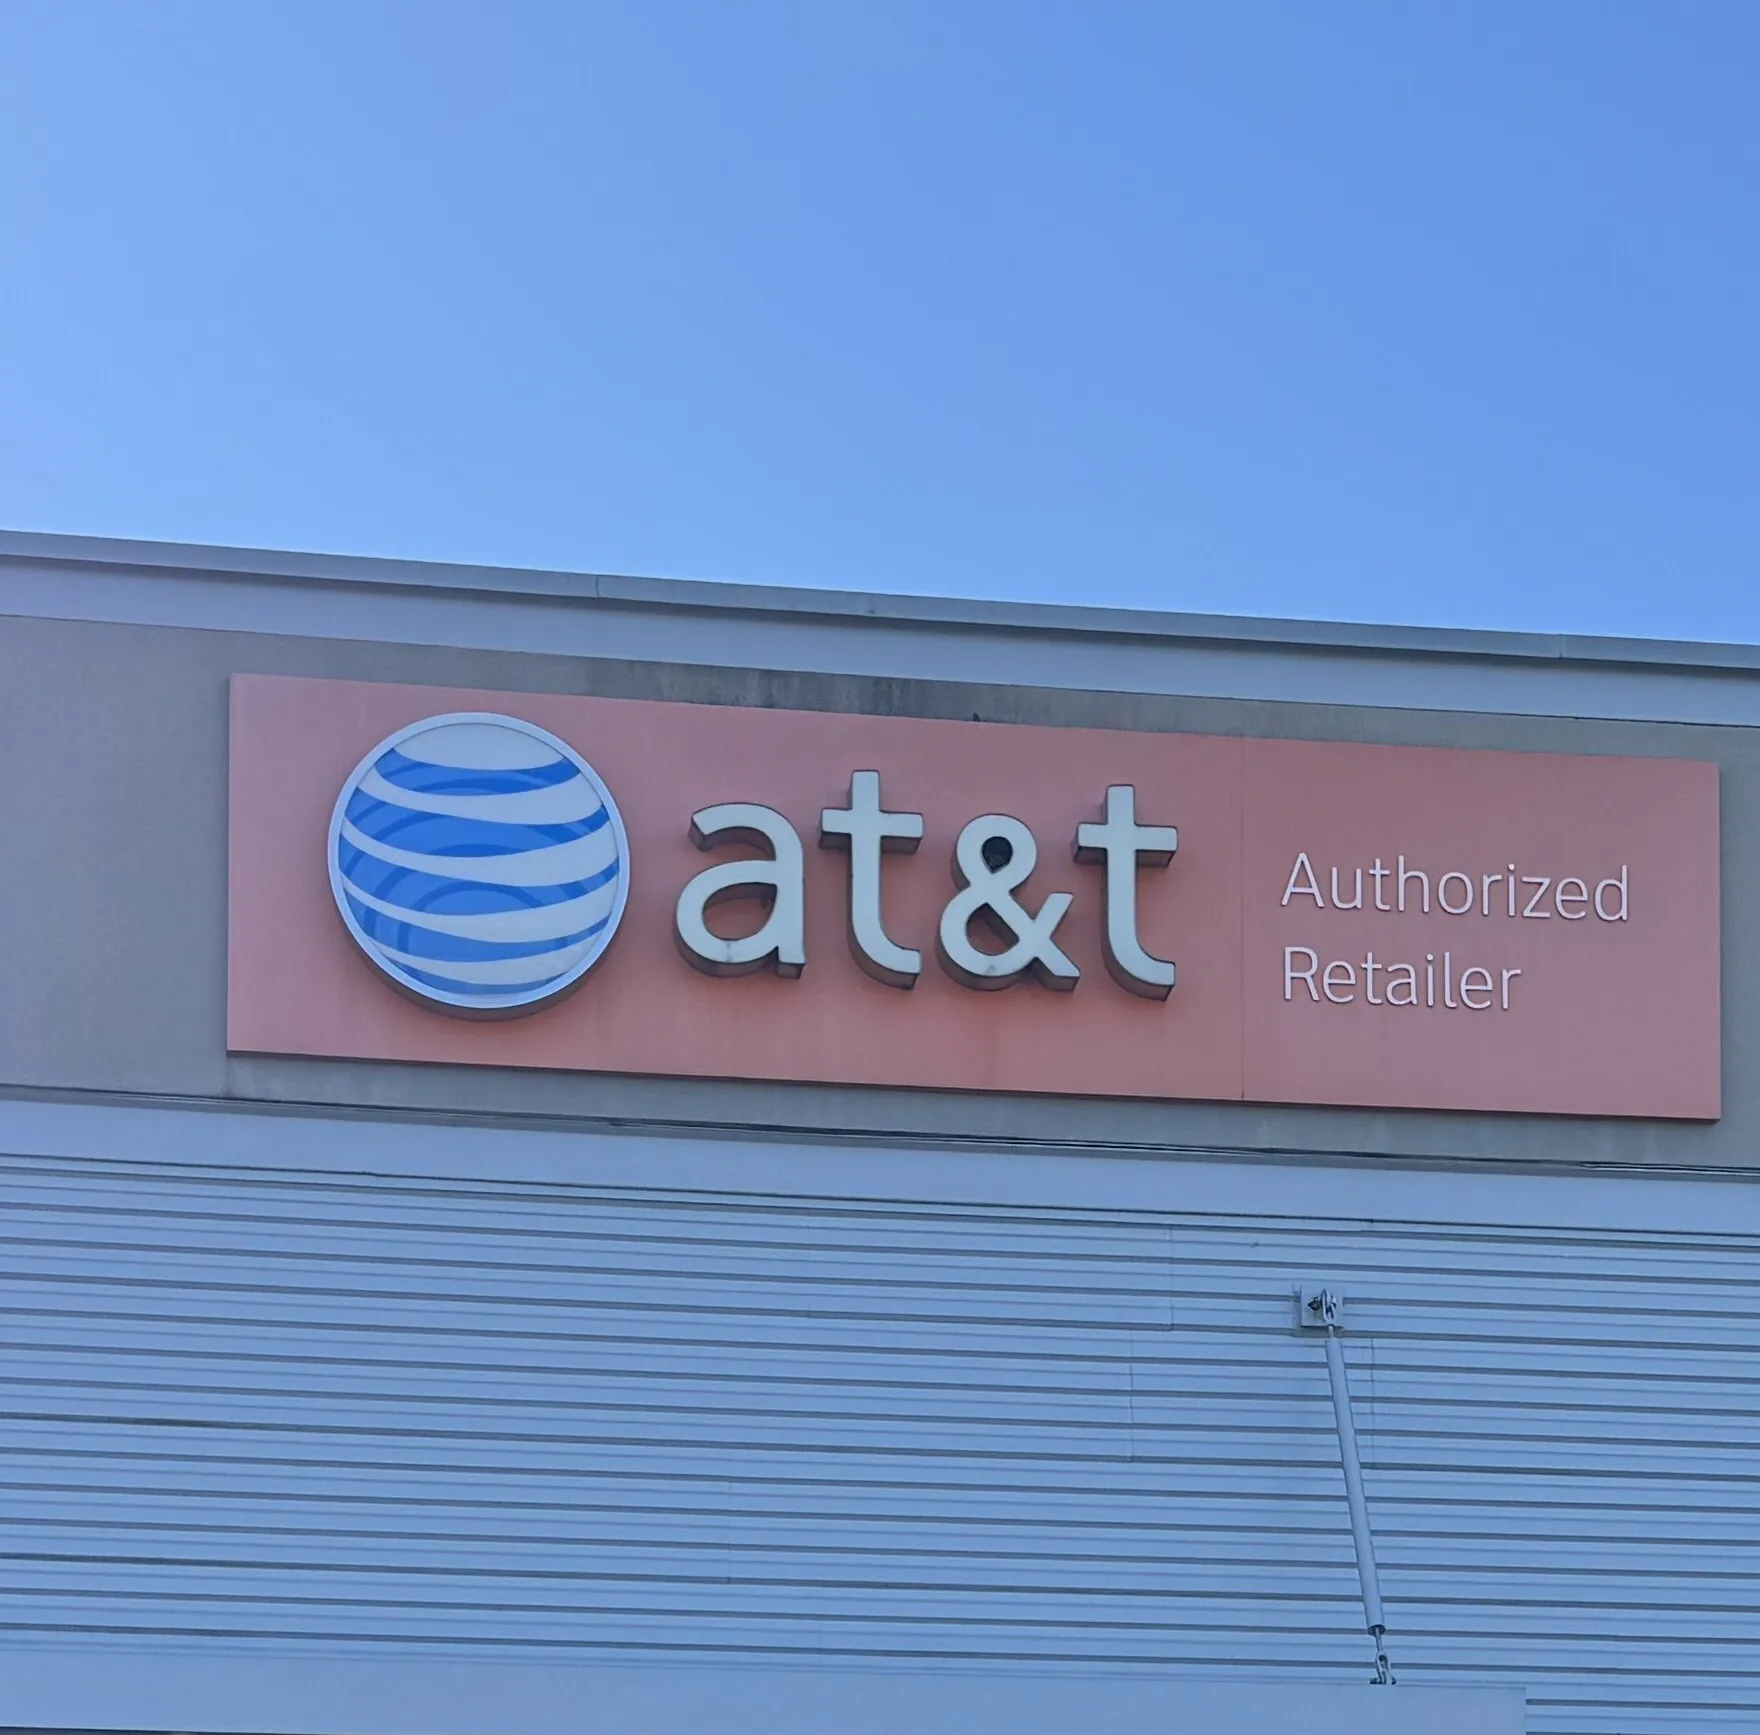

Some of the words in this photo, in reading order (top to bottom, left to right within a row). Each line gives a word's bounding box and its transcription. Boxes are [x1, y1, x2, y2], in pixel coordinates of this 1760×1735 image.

[674, 768, 1180, 1002] at&t
[1281, 850, 1632, 922] Authorized
[1281, 944, 1522, 1012] Retailer
